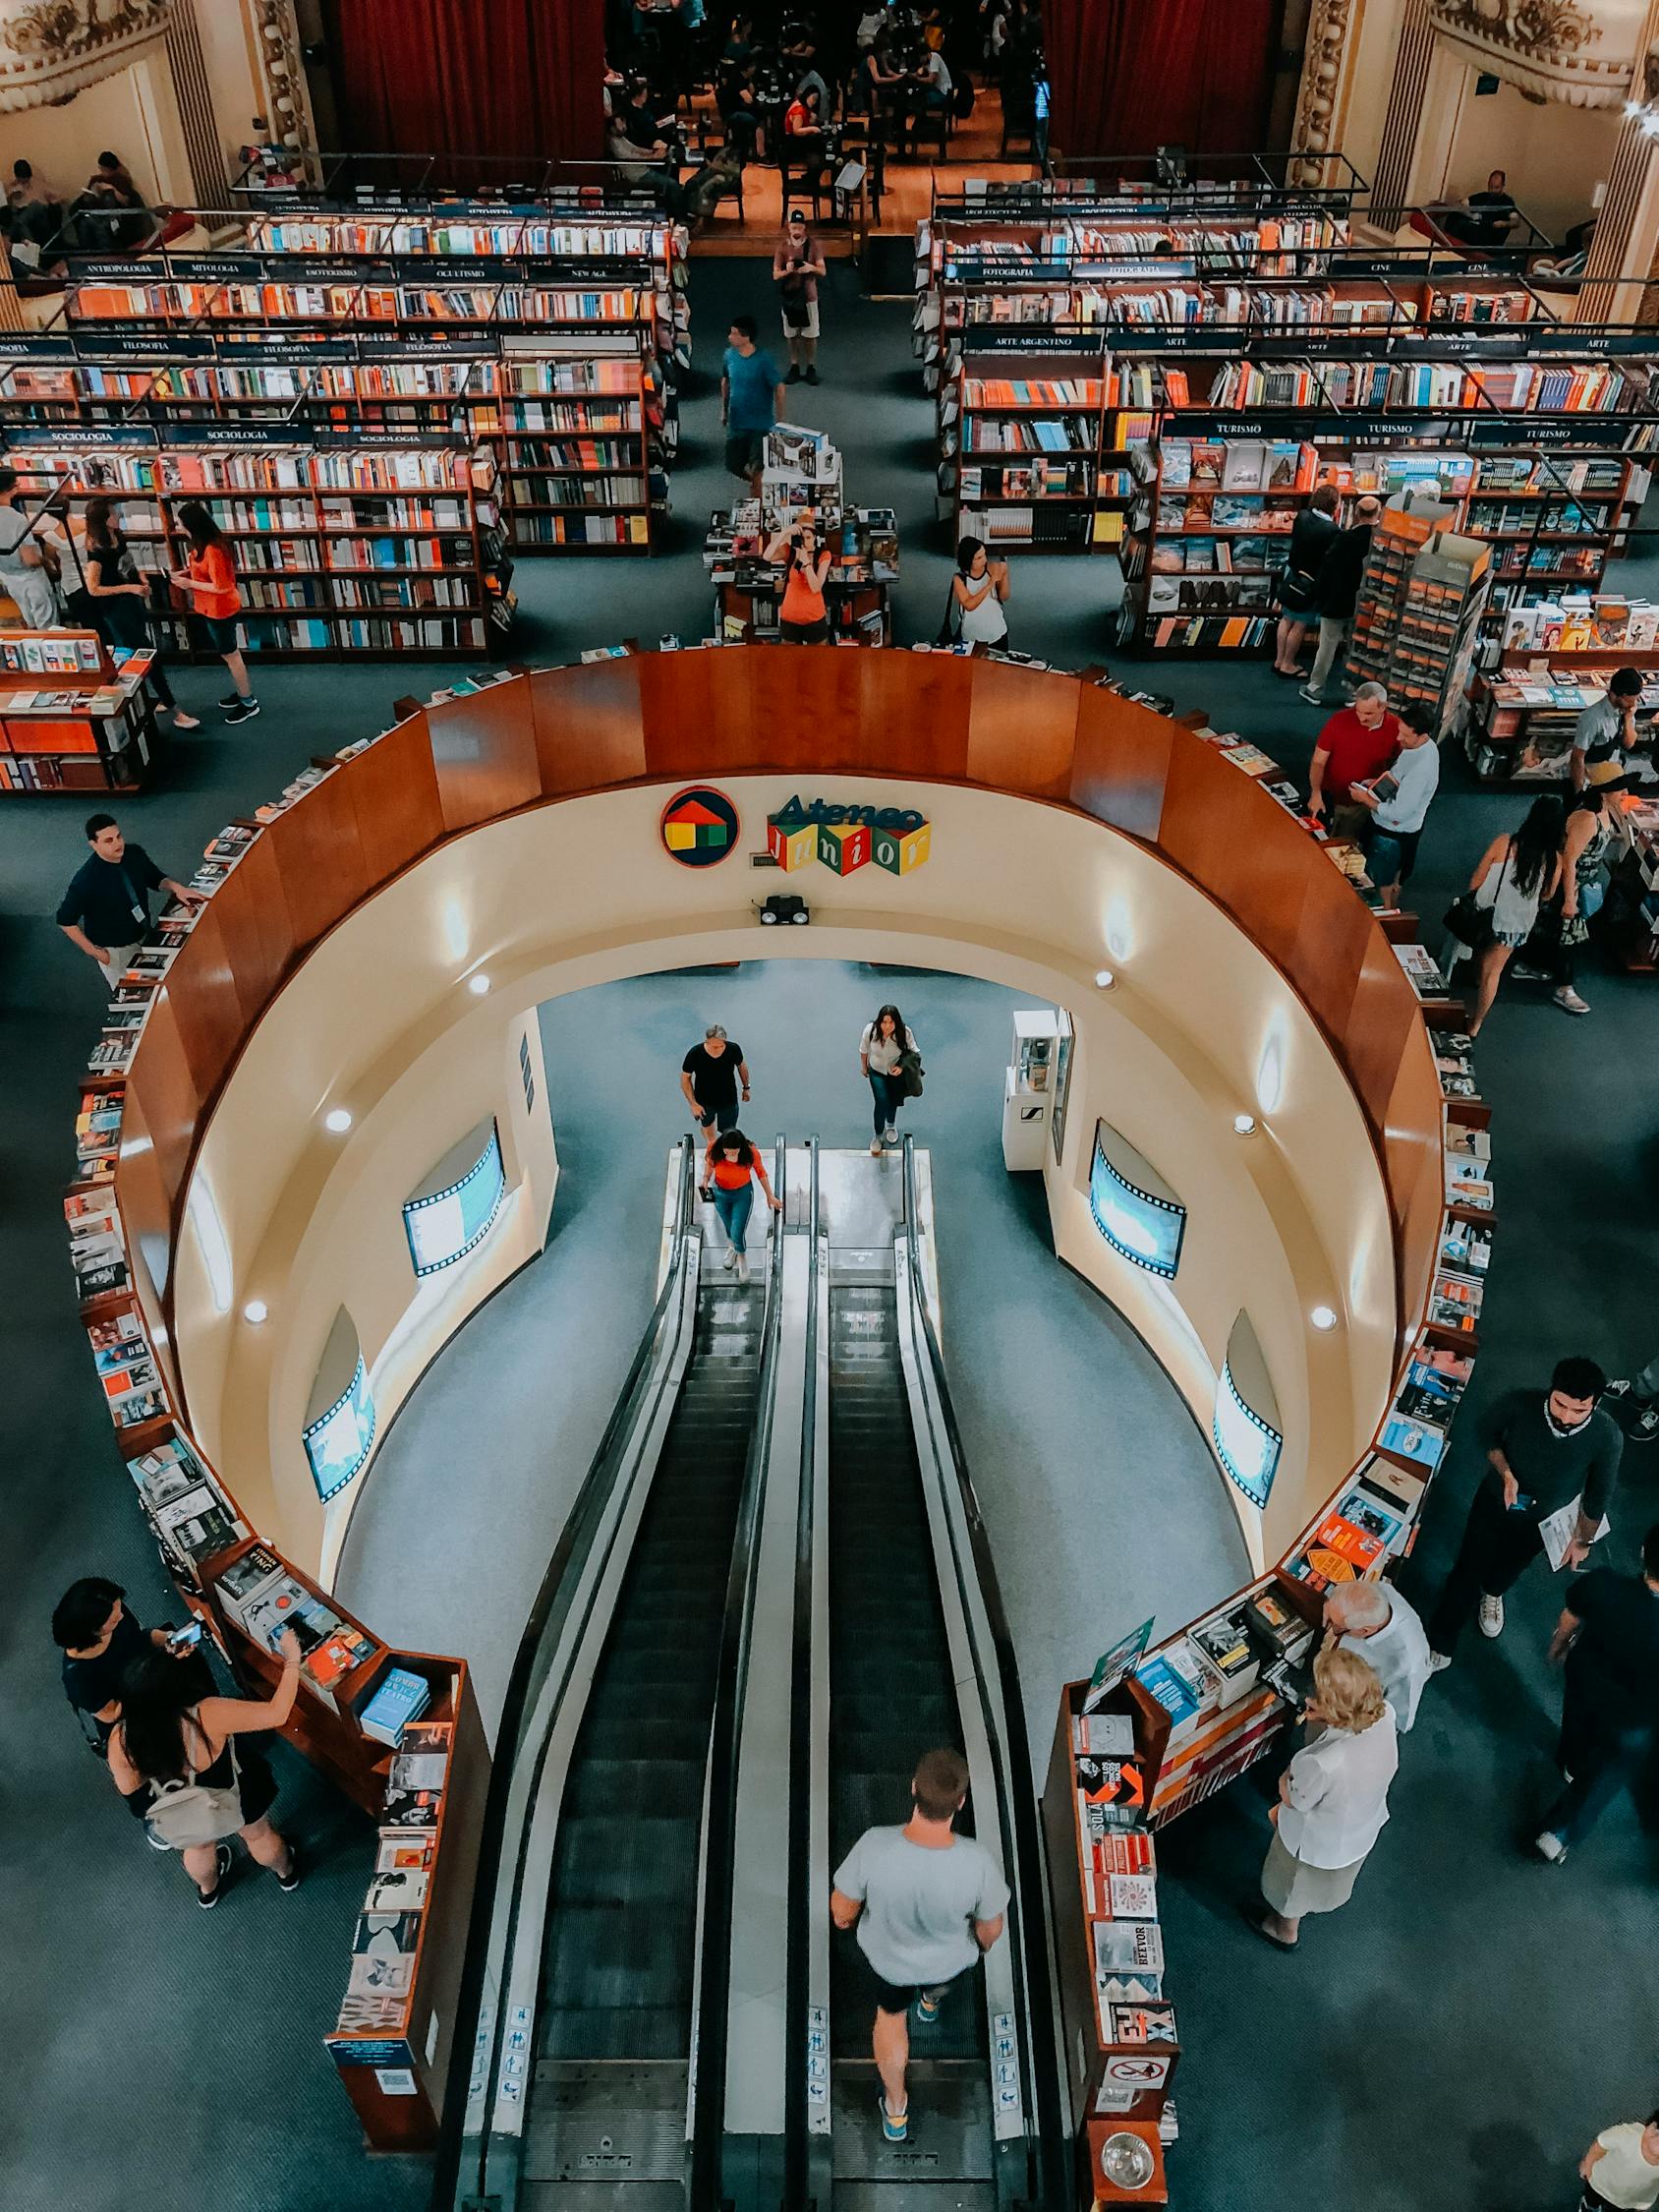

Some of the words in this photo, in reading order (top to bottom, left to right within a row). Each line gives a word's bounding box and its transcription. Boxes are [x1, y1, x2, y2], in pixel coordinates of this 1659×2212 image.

[87, 264, 151, 273] ANTROPOLOGIA
[192, 263, 239, 273] MITOLOGIA
[1110, 265, 1160, 274] FOTOGRAFIA
[123, 341, 169, 350] FILOSOFIA
[996, 337, 1017, 346] ARTE
[1019, 337, 1072, 346] ARGENTINO
[1165, 337, 1187, 346] ARTE
[1587, 339, 1611, 348] ARTE
[1217, 424, 1262, 434] TURISMO
[1368, 424, 1413, 434] TURISMO
[52, 433, 113, 441] SOCIOLOGIA
[207, 431, 268, 439] SOCIOLOGIA
[1526, 430, 1571, 438] TURISMO
[775, 794, 924, 830] Ateneo
[770, 829, 928, 866] Junior
[250, 1551, 273, 1573] KING
[1135, 1927, 1149, 1965] BEEVOR
